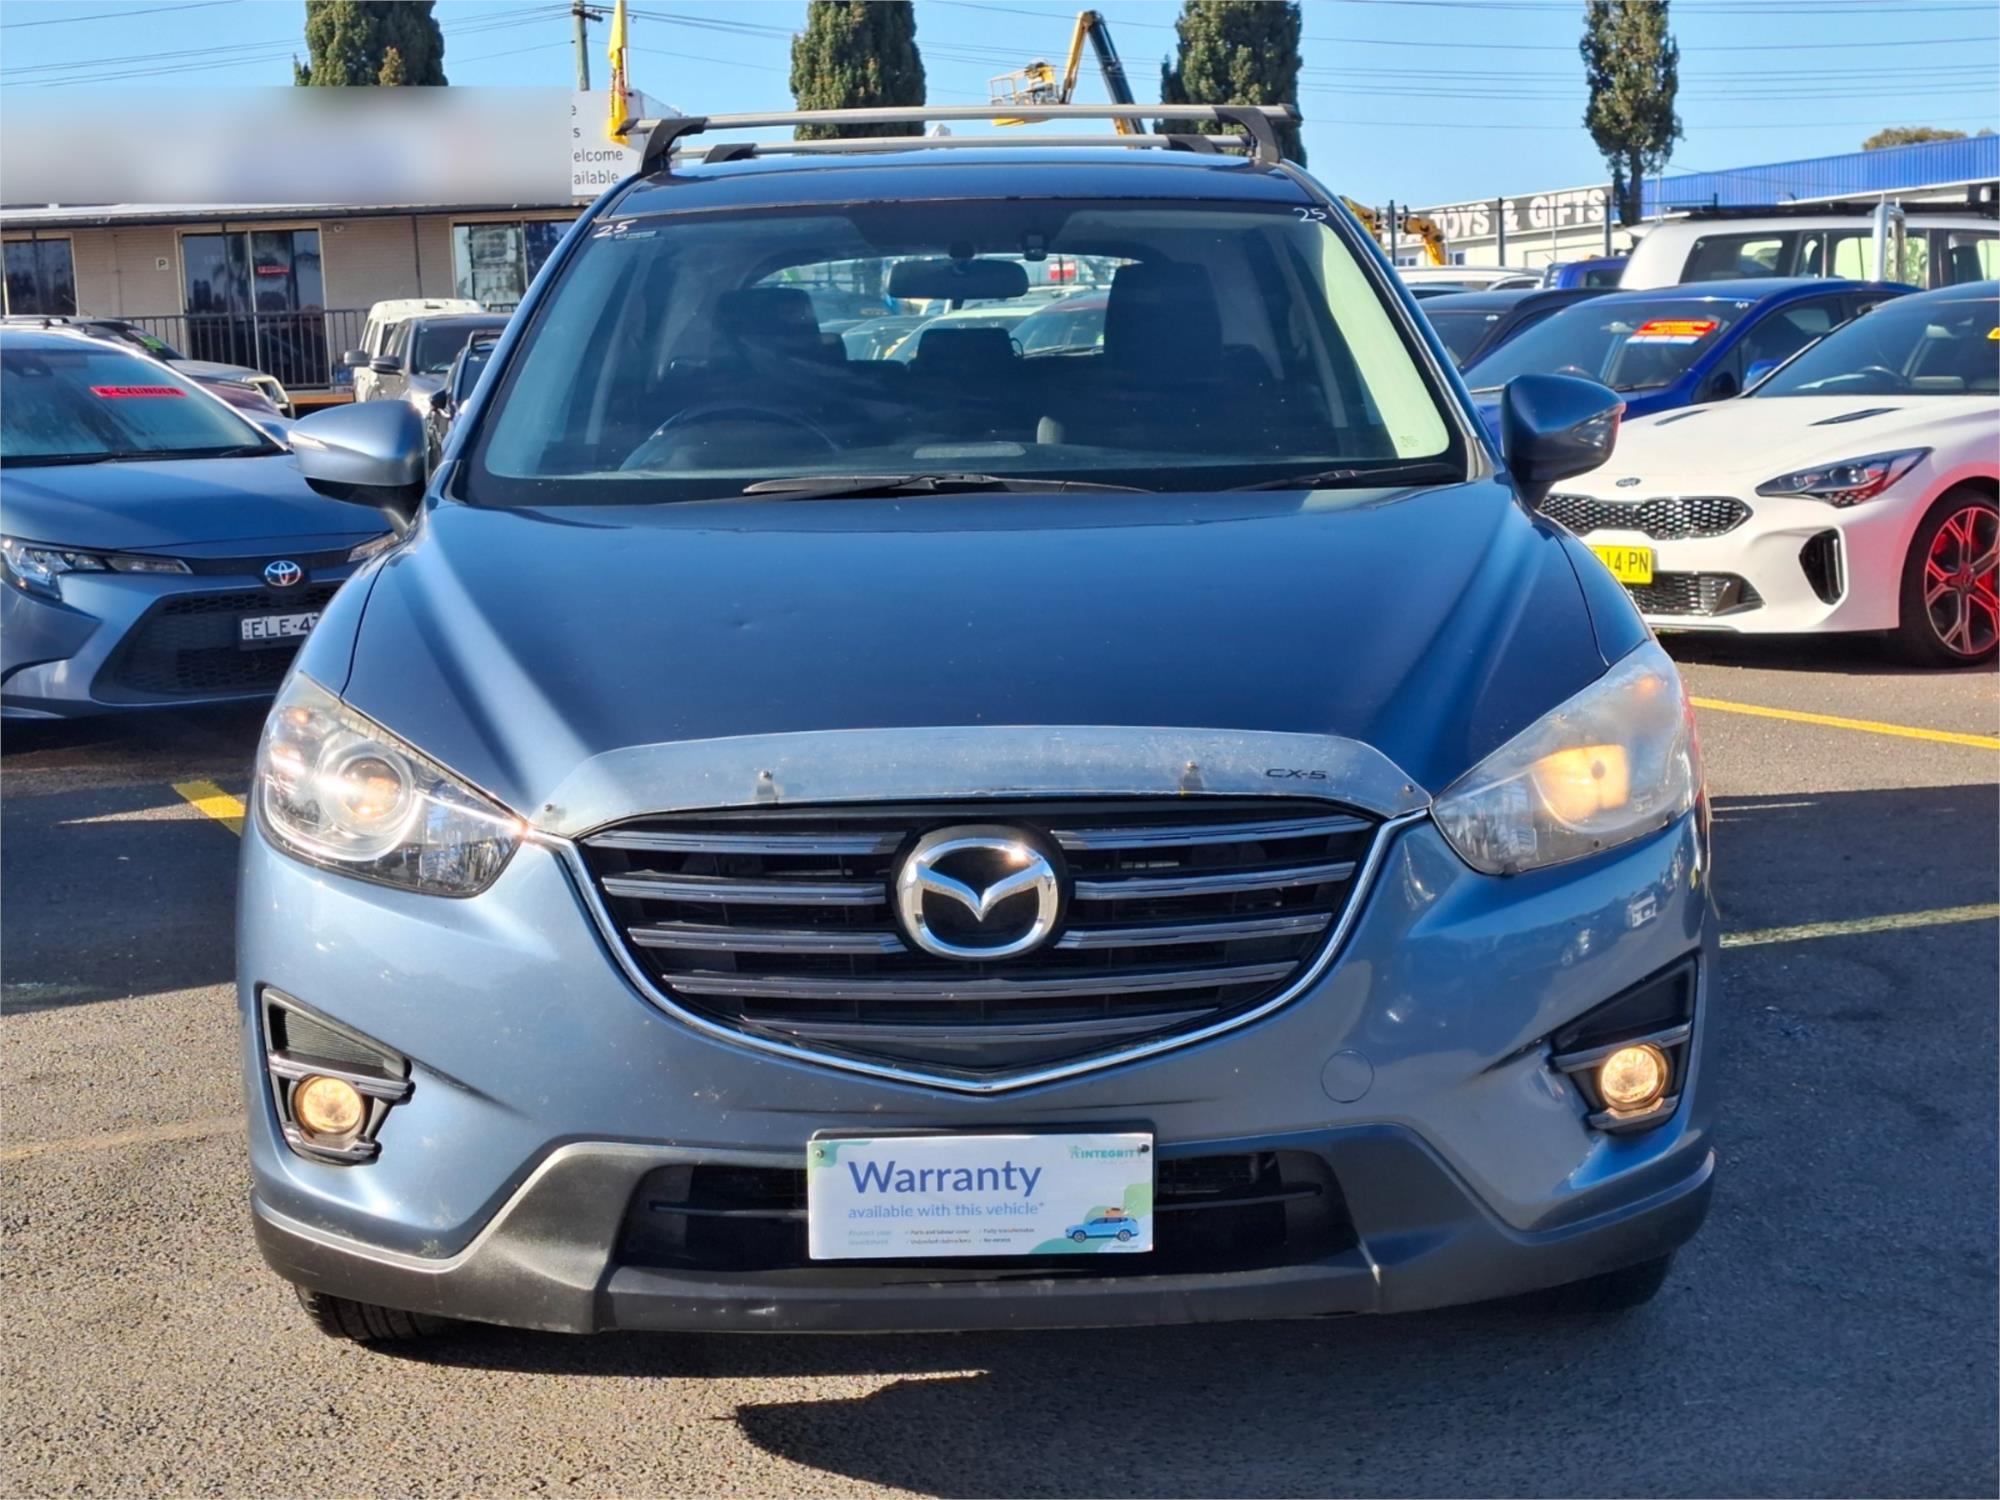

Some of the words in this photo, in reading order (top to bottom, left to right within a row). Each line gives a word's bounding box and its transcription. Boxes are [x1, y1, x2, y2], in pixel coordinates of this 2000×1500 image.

[573, 149, 623, 162] elcome
[1293, 207, 1328, 222] 25
[1429, 203, 1489, 239] TOYS
[1502, 200, 1521, 231] &
[1529, 188, 1606, 230] GIFTS
[592, 219, 637, 239] 25
[1266, 768, 1327, 780] CX-5
[848, 1161, 1042, 1198] Warranty
[848, 1204, 914, 1219] available
[917, 1203, 950, 1217] with
[955, 1202, 982, 1216] this
